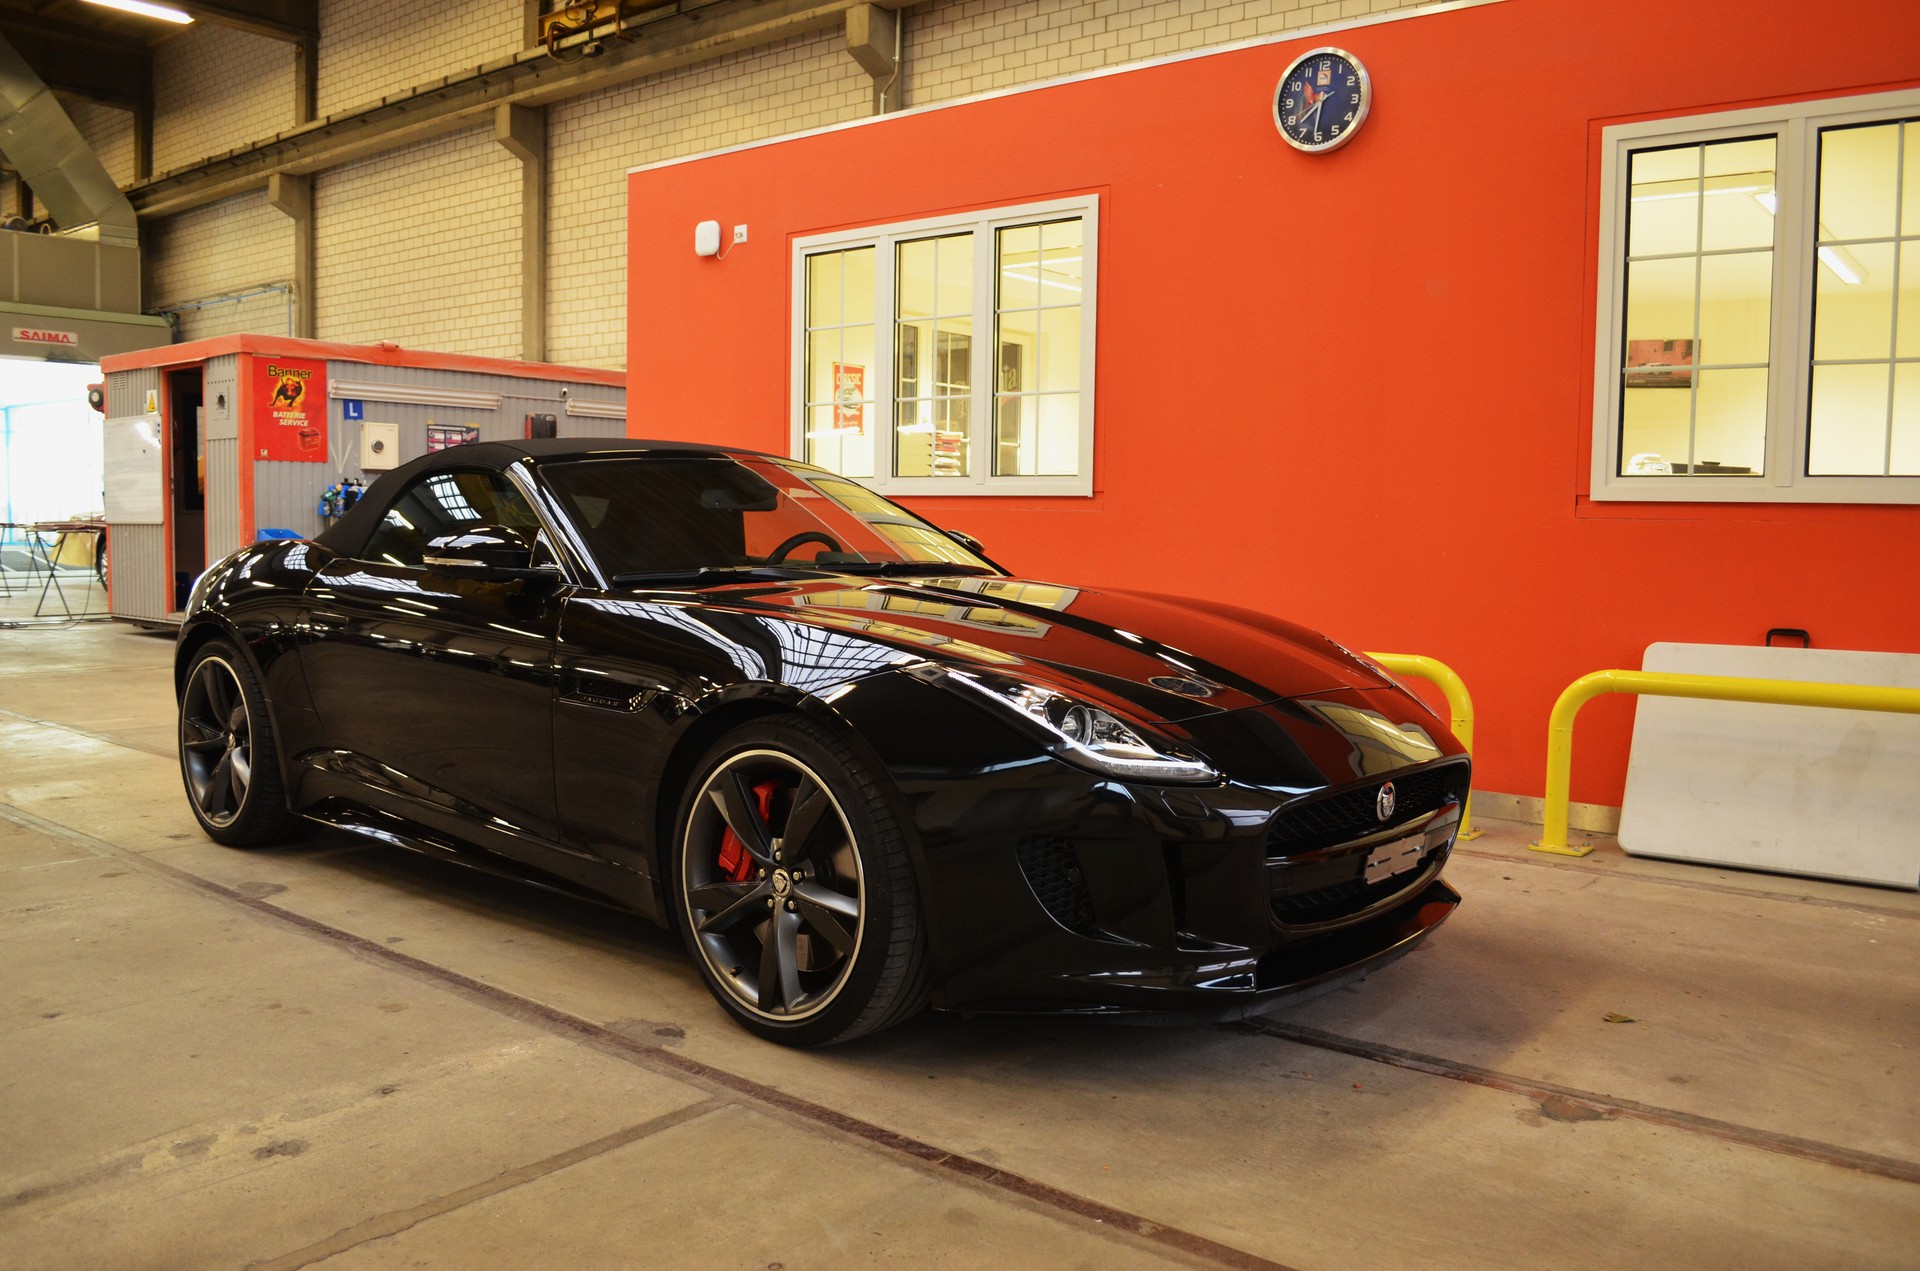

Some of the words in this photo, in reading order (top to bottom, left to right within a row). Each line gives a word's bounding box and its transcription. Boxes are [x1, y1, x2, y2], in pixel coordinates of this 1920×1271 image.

[1320, 61, 1330, 70] 12
[1339, 64, 1342, 74] 1
[1305, 68, 1312, 77] 11
[1347, 76, 1355, 86] 2
[1292, 82, 1301, 91] 10
[1286, 99, 1294, 108] 9
[1351, 94, 1359, 104] 3
[1288, 116, 1296, 125] 8
[1344, 112, 1353, 121] 4
[1300, 128, 1307, 138] 7
[1331, 125, 1339, 135] 5
[1314, 132, 1322, 141] 6
[20, 329, 71, 344] SAIMA
[268, 365, 312, 379] Banner
[836, 374, 861, 385] CASSIC
[349, 402, 359, 417] L
[272, 411, 306, 419] BATTERIE
[279, 418, 309, 427] SERVICE
